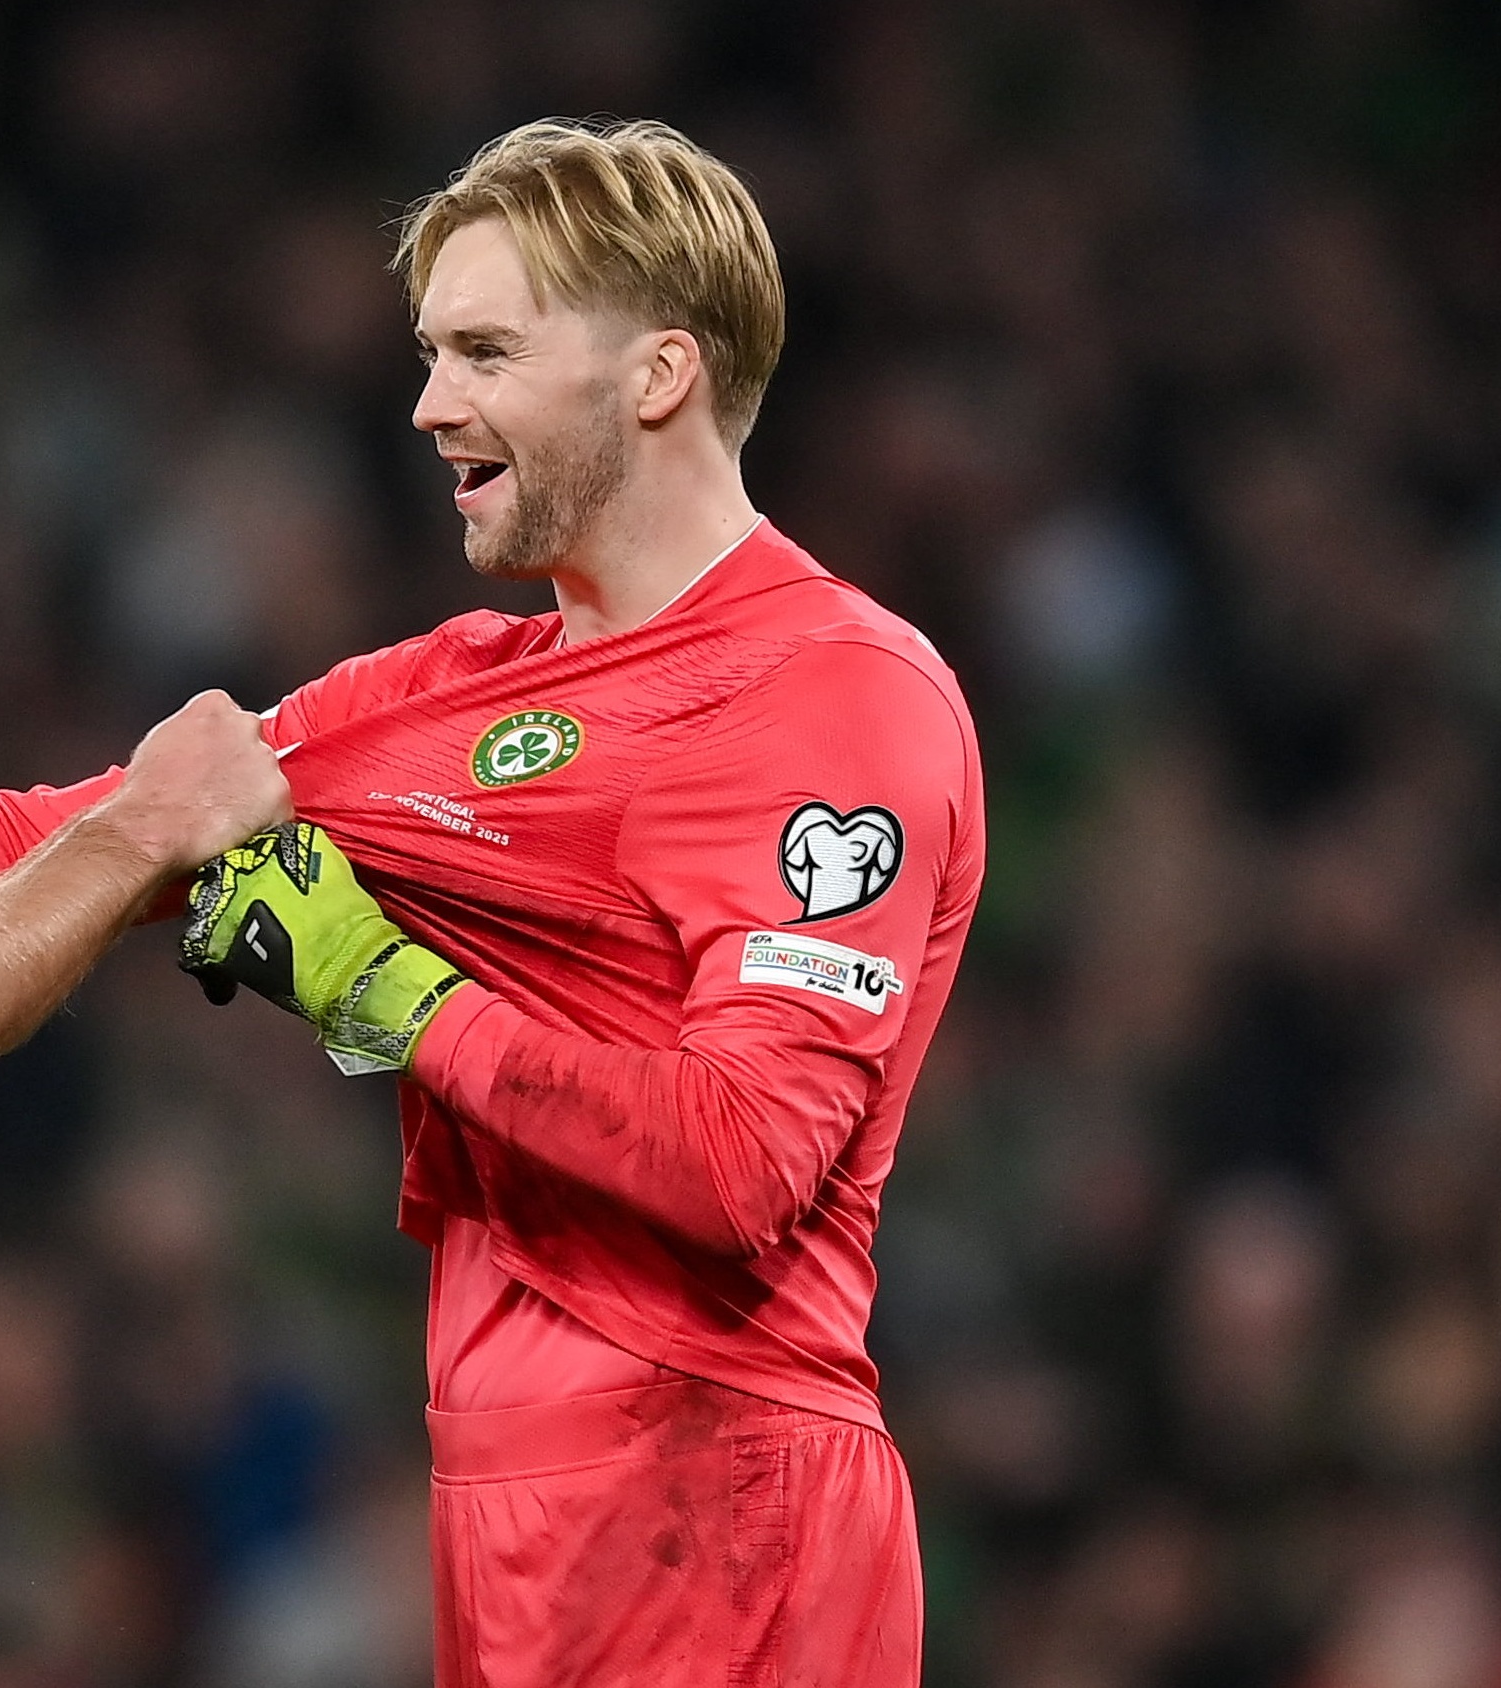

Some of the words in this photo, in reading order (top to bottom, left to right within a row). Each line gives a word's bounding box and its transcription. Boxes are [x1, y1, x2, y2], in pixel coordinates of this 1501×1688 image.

[511, 713, 577, 757] IRELAND
[392, 794, 472, 835] NOVEMBER
[475, 826, 510, 847] 2025
[748, 934, 773, 945] UEFA
[745, 950, 850, 981] FOUNDATION
[852, 961, 884, 997] 10
